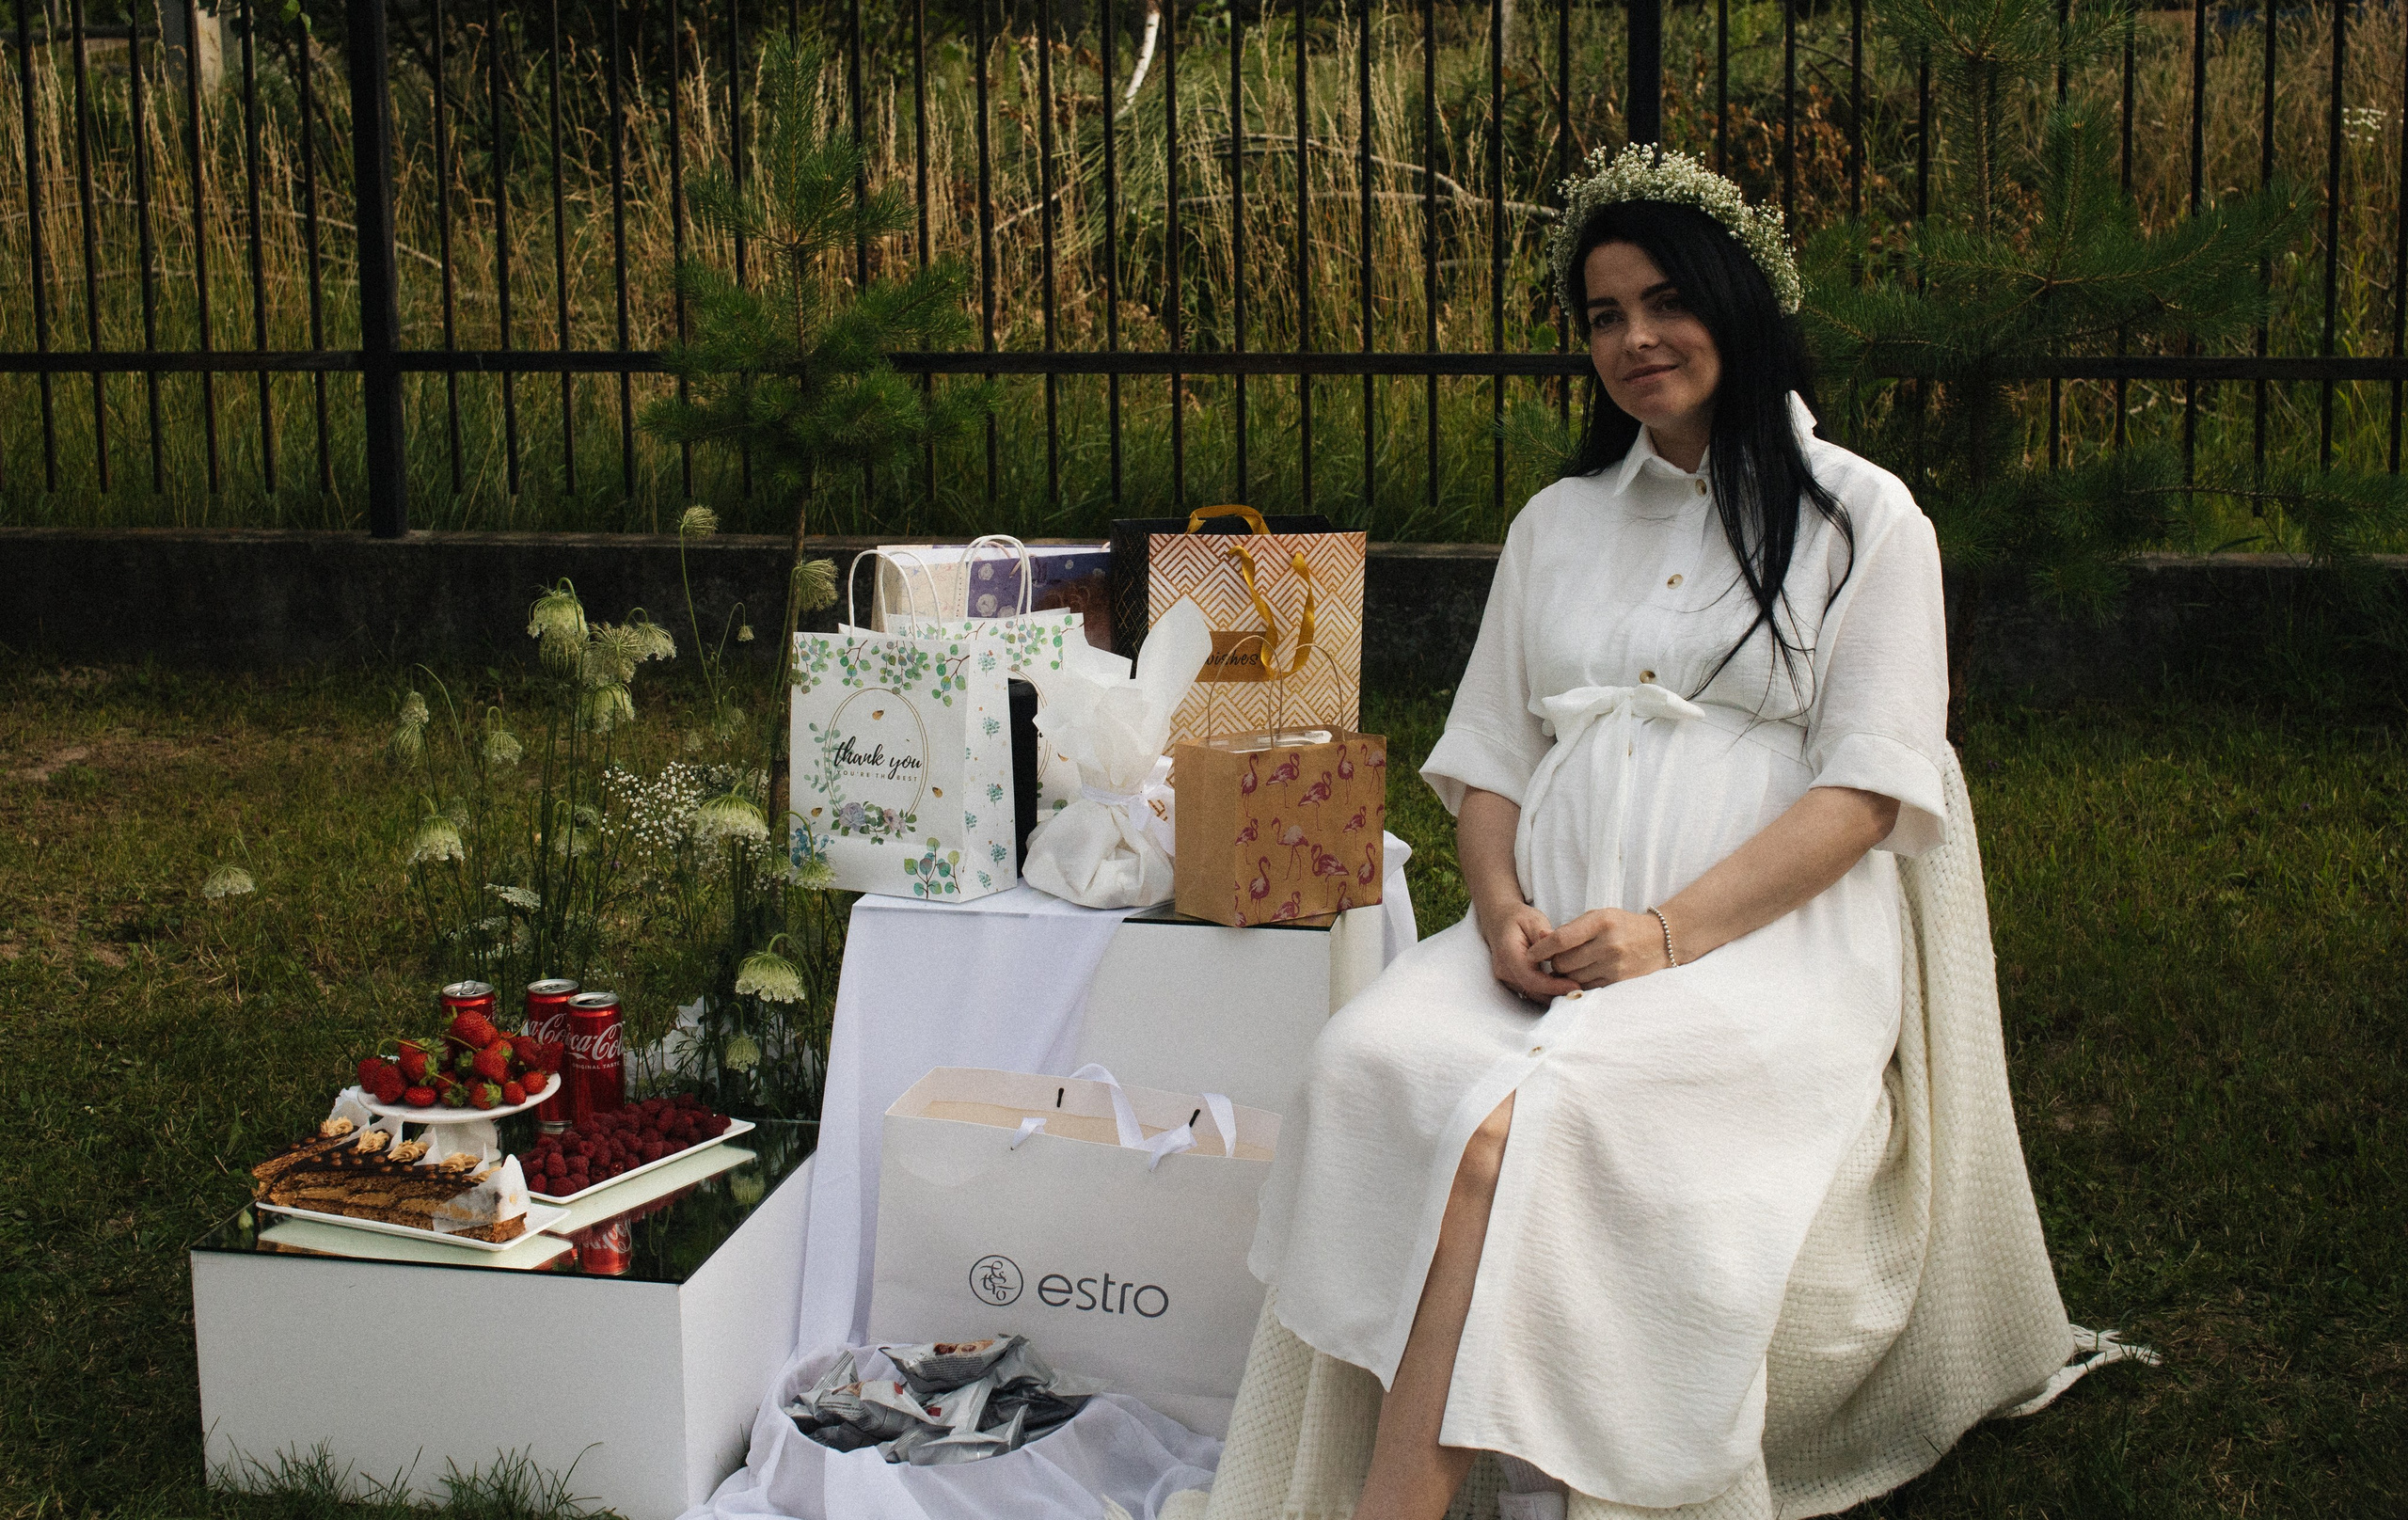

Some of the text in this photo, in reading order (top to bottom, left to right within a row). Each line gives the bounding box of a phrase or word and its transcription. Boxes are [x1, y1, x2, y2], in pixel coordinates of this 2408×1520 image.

[833, 736, 923, 780] thank you
[836, 769, 870, 779] YOU'RE
[895, 774, 918, 783] BEST
[1038, 1273, 1169, 1318] estro
